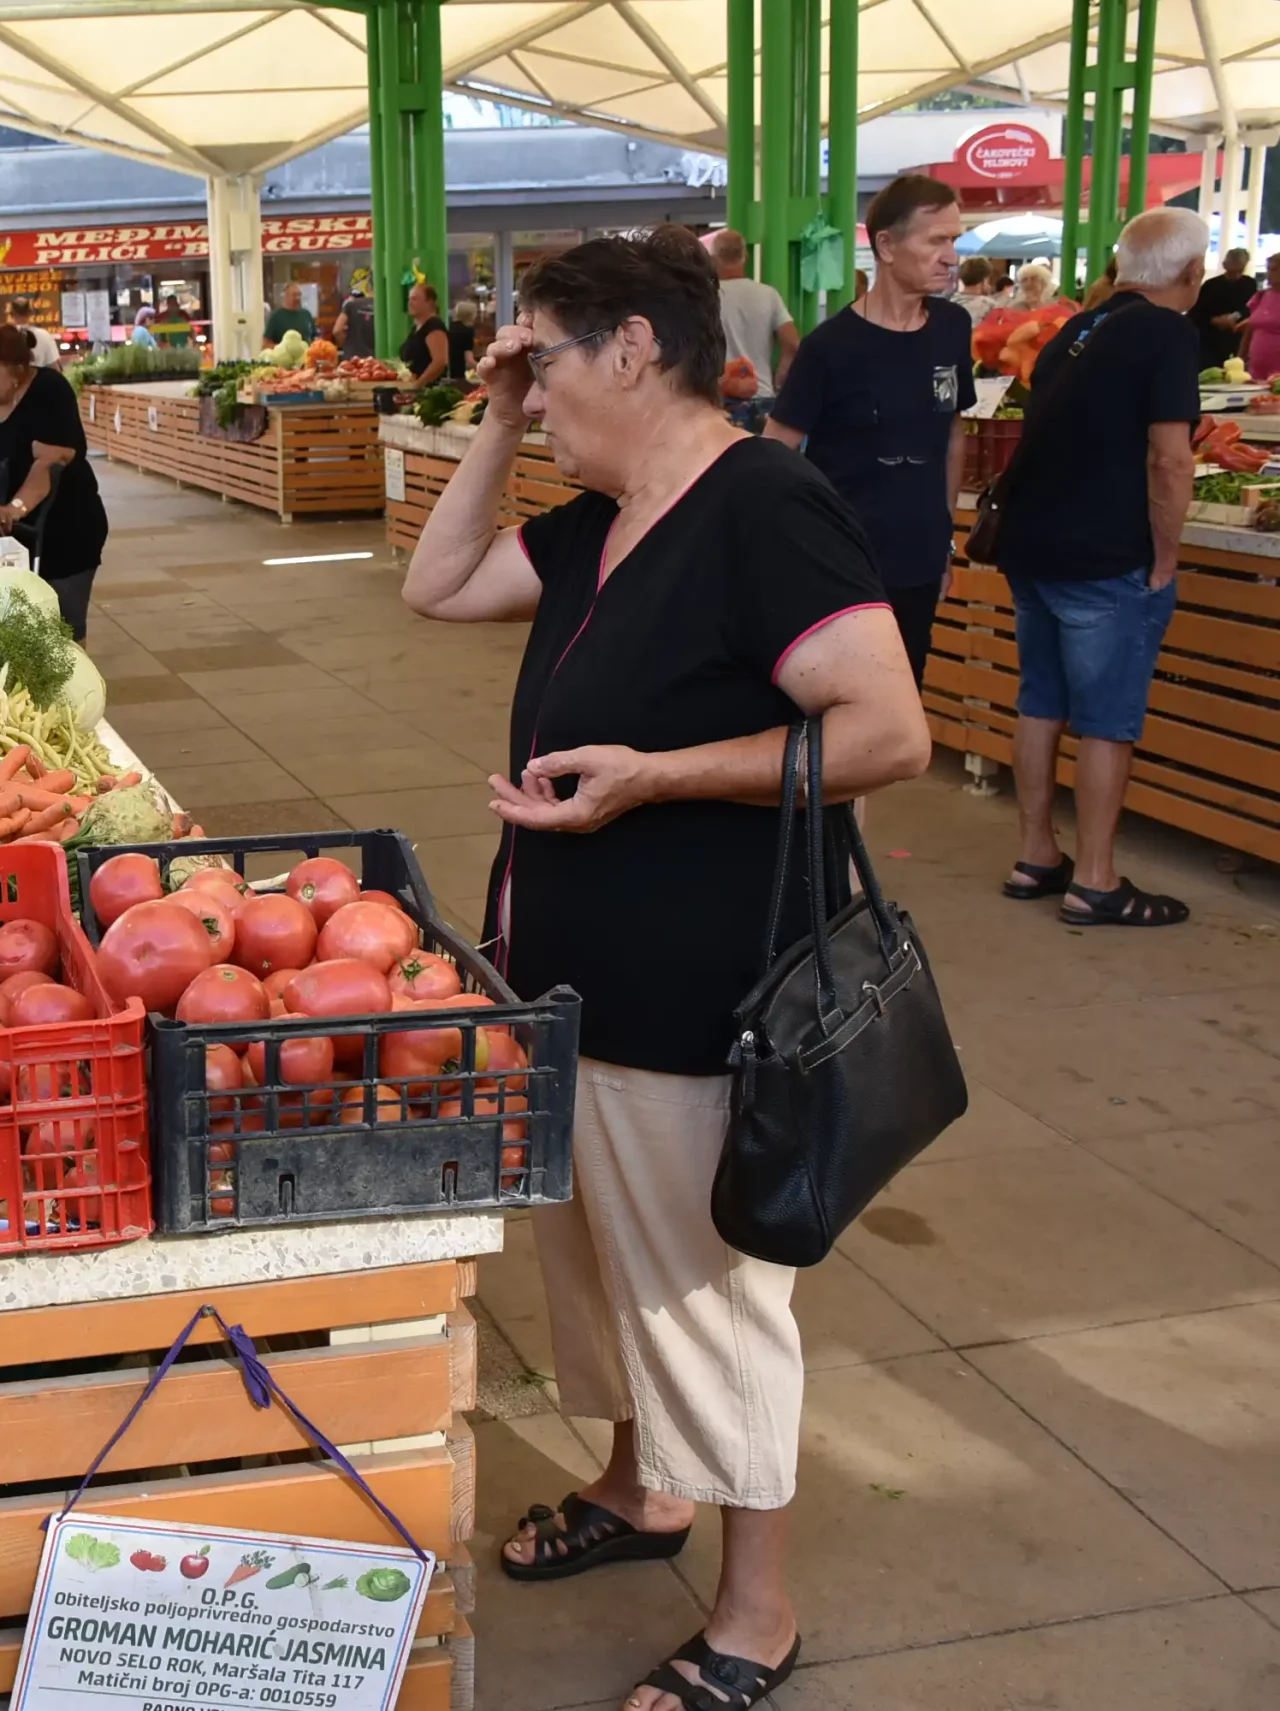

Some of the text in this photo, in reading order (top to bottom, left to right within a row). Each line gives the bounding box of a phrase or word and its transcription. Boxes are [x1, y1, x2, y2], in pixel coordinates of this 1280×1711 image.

[33, 216, 372, 248] MEĐIMRSKI
[34, 241, 150, 265] PILIĆI
[54, 1591, 395, 1638] Obiteljsko poljoprivredno gospodarstvo
[201, 1588, 259, 1610] O.P.G.
[47, 1616, 386, 1671] GROMAN MOHARIĆ JASMINA
[59, 1647, 365, 1690] NOVO SELO ROK, Maršala Tita 117
[77, 1670, 337, 1708] Matični broj OPG-a: 0010559
